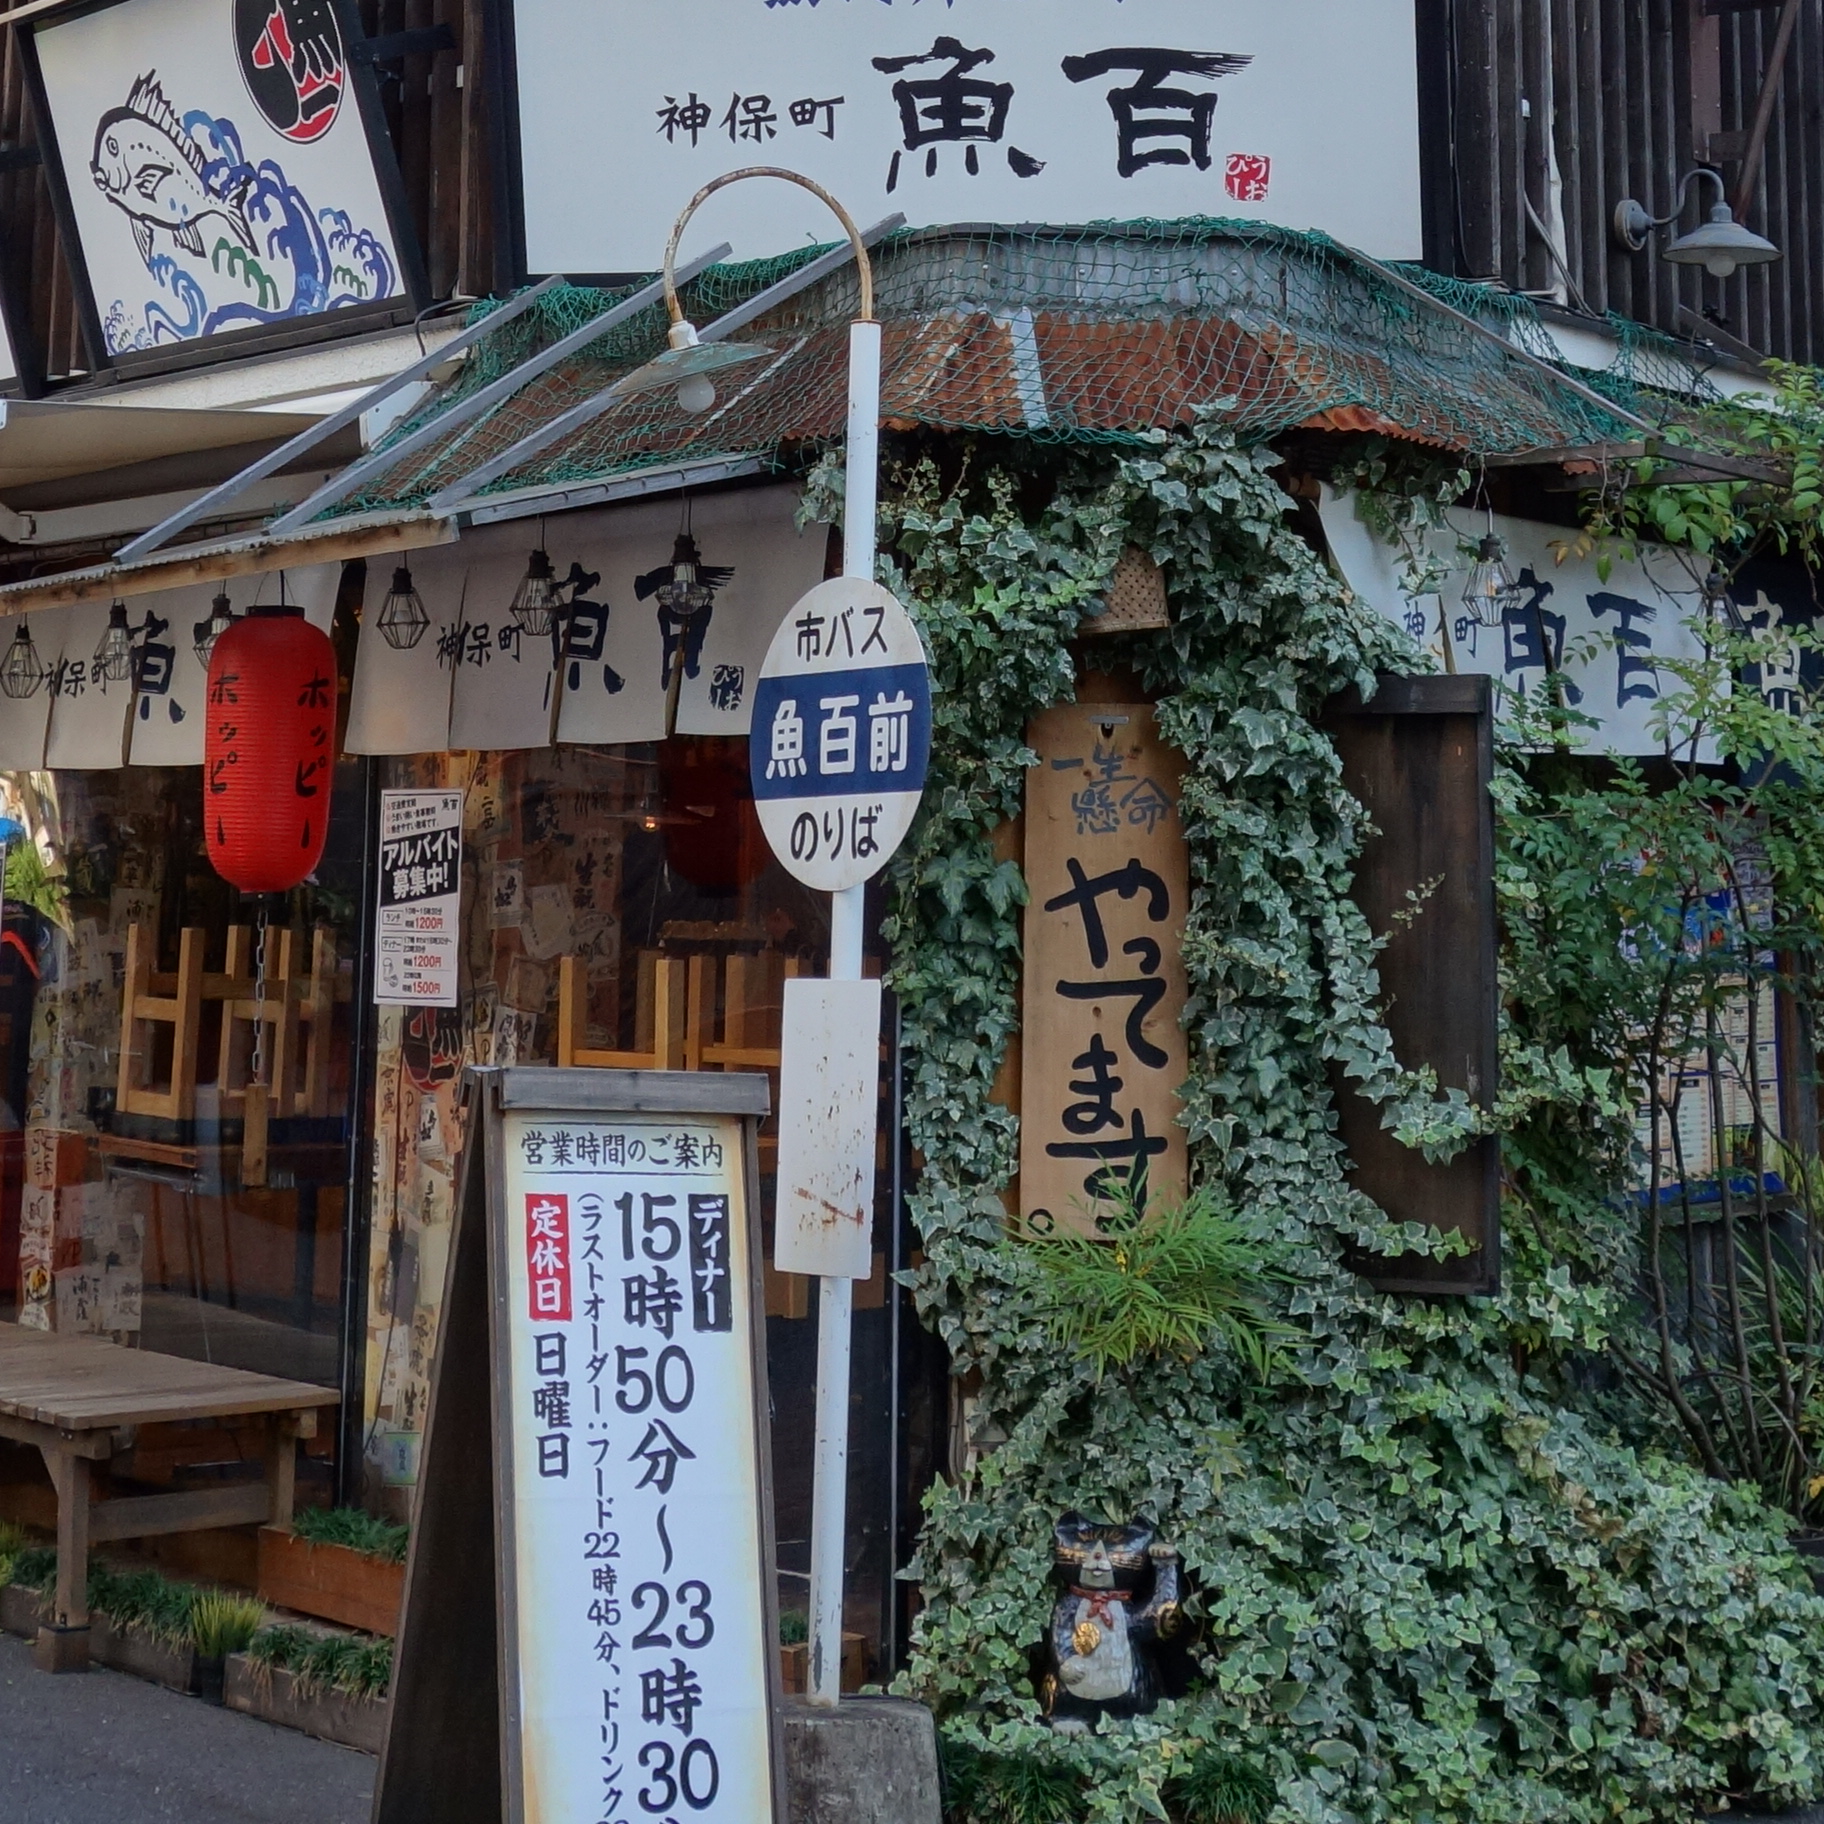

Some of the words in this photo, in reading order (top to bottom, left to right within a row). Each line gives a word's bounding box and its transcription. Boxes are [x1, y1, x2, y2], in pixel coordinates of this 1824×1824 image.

[654, 91, 846, 149] 神保町
[870, 36, 1256, 195] 魚百
[796, 606, 888, 662] 市バス
[295, 666, 330, 850] ホッピー
[766, 690, 913, 780] 魚百前
[1050, 744, 1137, 787] 一生
[791, 804, 883, 862] のりば
[1070, 778, 1174, 836] 懸命
[383, 830, 459, 871] アルバイト
[415, 917, 443, 930] 1200円
[412, 982, 441, 995] 1500円
[413, 955, 442, 968] 1200円
[520, 1131, 724, 1169] 営業時間のご案内
[530, 1197, 563, 1316] 定休日
[691, 1198, 724, 1328] ディナー
[532, 1331, 573, 1481] 日曜日
[613, 1191, 722, 1824] 15時50分〜23時30
